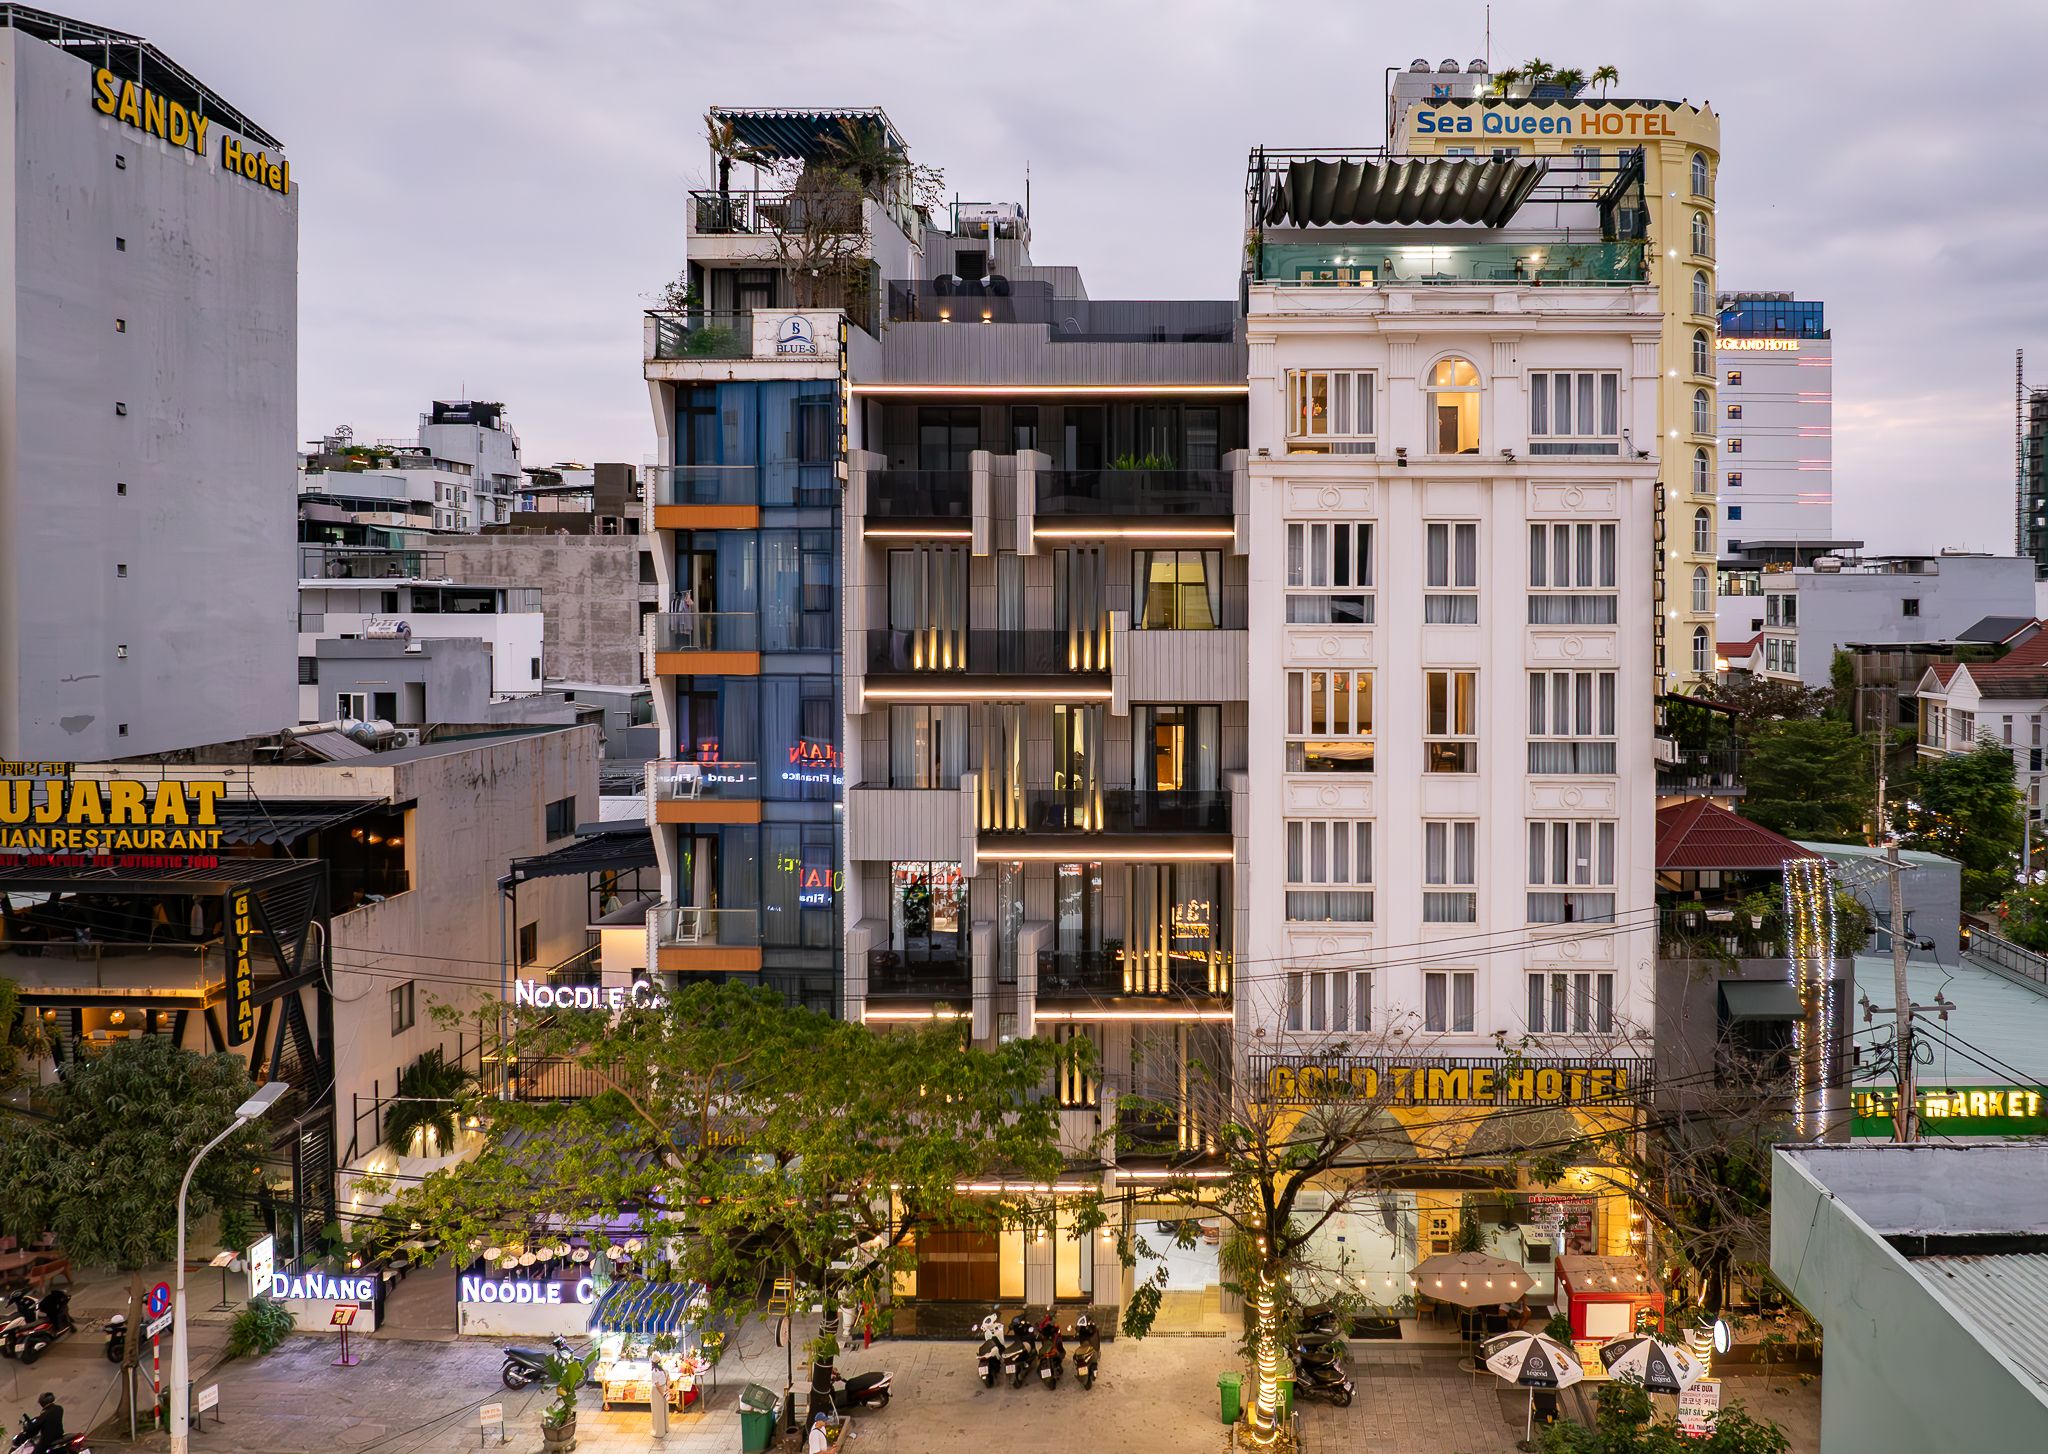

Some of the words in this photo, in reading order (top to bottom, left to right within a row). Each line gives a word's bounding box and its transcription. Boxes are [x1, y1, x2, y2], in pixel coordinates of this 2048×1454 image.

[96, 68, 209, 155] SANDY
[223, 135, 290, 195] Hotel
[1417, 111, 1473, 133] Sea
[1483, 112, 1572, 134] Queen
[1581, 113, 1676, 136] HOTEL
[776, 344, 816, 354] BLUE-S
[1722, 337, 1765, 350] GRAND
[1765, 339, 1800, 350] HOTEL
[51, 829, 223, 849] RESTAURANT
[188, 856, 218, 868] FOOD
[235, 895, 252, 1041] GUJARAT
[1394, 1066, 1495, 1100] TIME
[1925, 1090, 2041, 1118] MARKET
[462, 1277, 562, 1305] NOODLE
